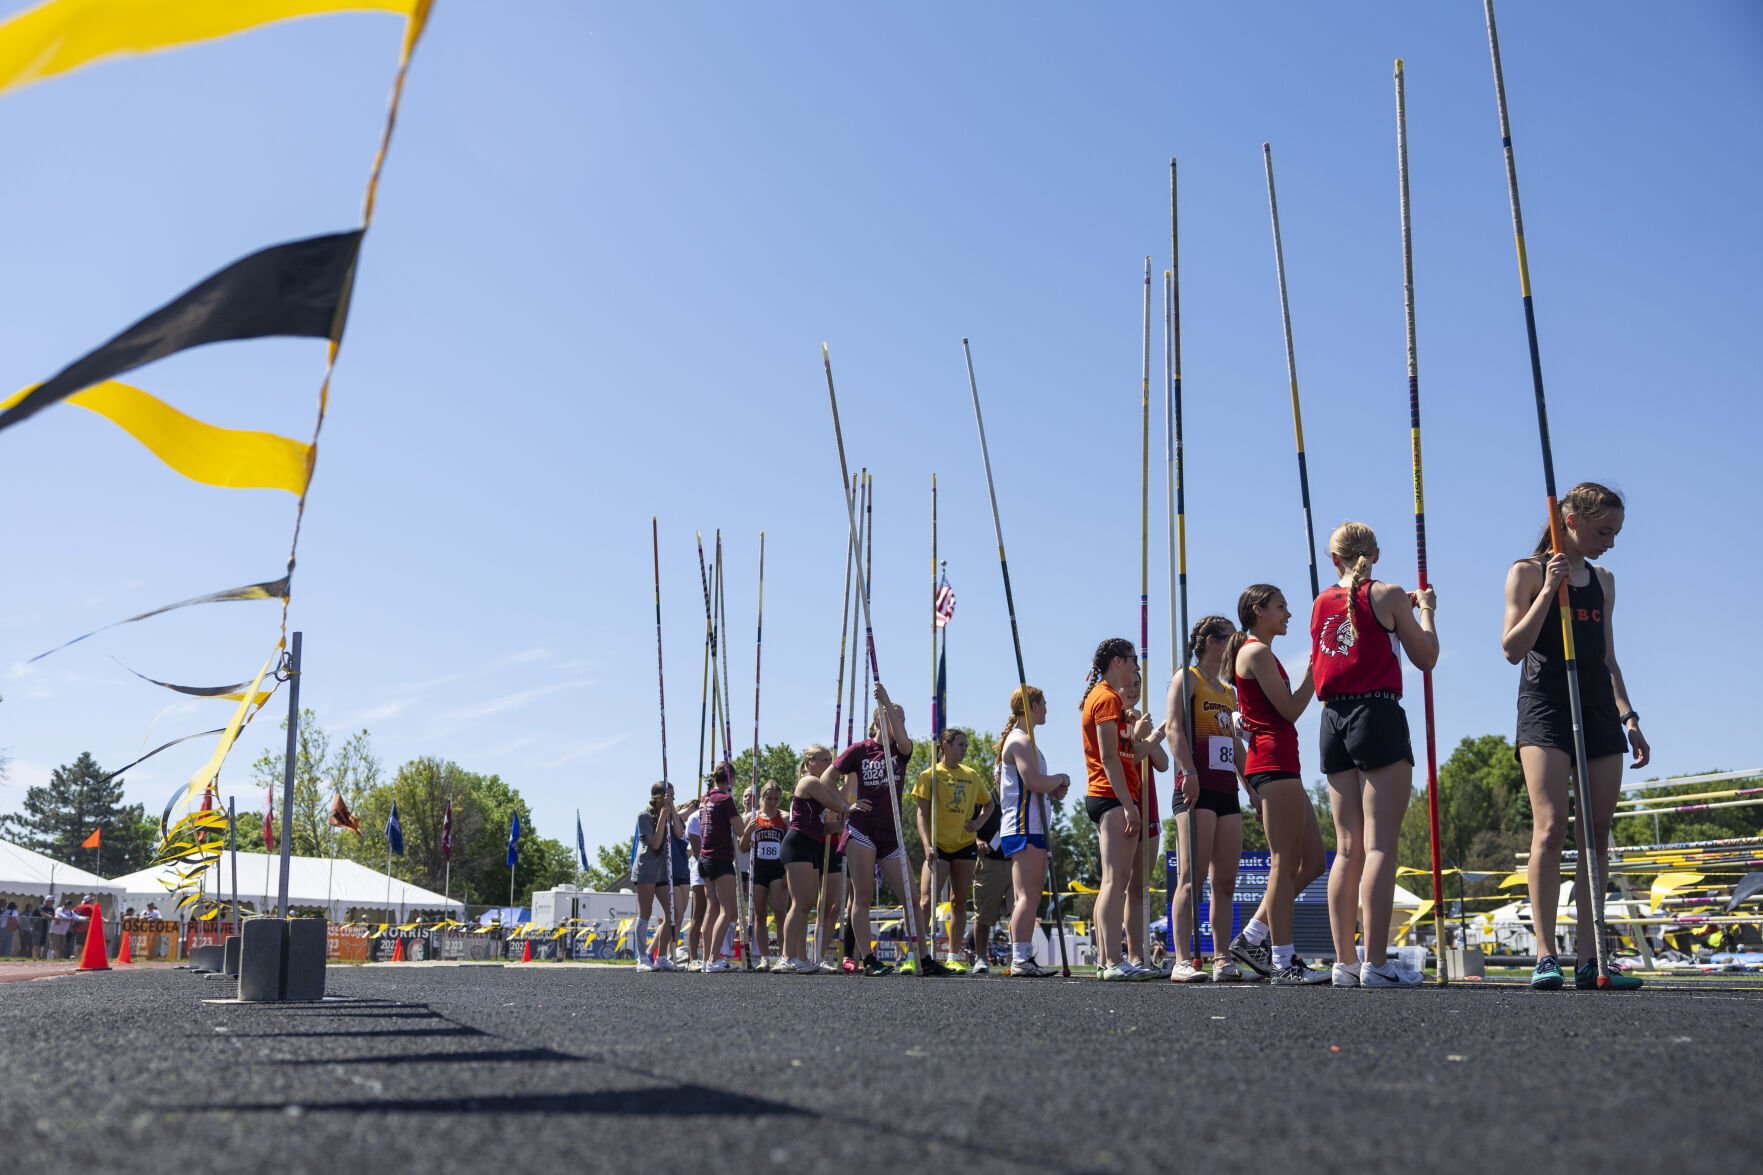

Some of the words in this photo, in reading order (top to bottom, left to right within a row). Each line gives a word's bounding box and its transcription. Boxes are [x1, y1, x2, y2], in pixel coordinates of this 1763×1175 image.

[1414, 469, 1422, 504] MYSTIC
[1570, 608, 1601, 622] BC
[863, 769, 884, 780] 2024
[761, 847, 777, 856] 186
[123, 919, 179, 933] OSCEOLA
[378, 927, 429, 938] NORRIS
[192, 936, 213, 947] 223
[380, 941, 396, 949] 202
[510, 942, 525, 950] 202
